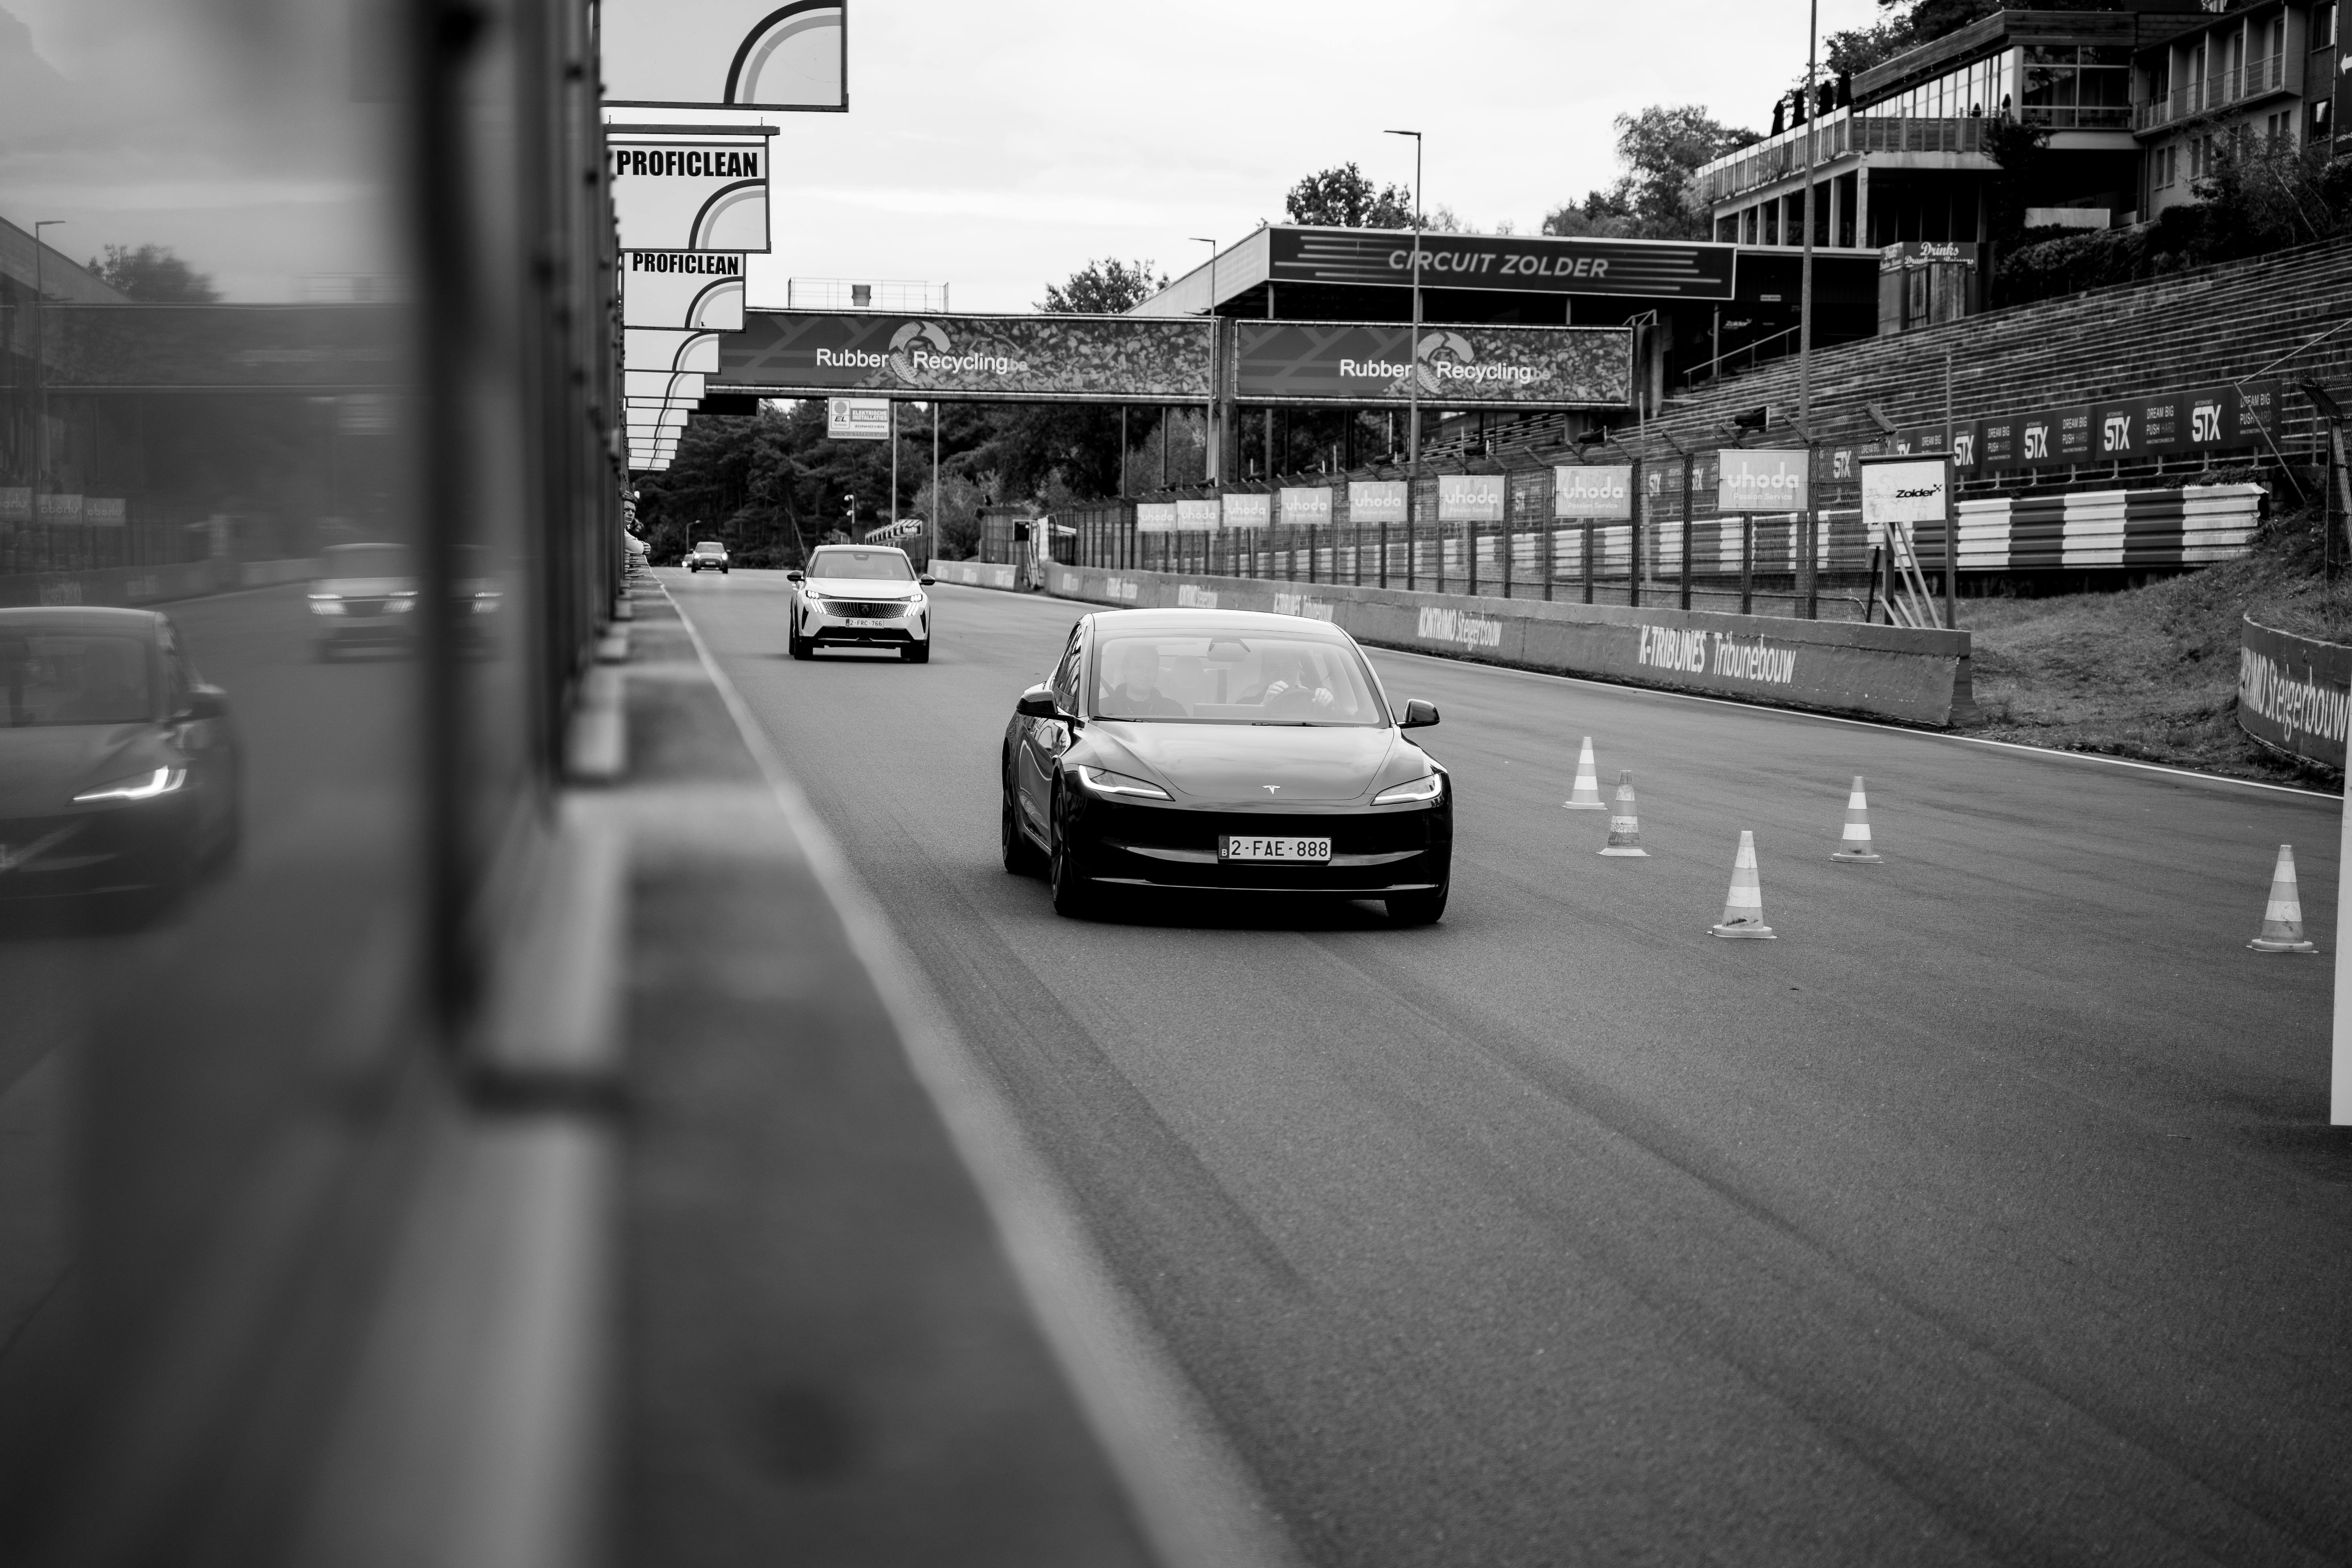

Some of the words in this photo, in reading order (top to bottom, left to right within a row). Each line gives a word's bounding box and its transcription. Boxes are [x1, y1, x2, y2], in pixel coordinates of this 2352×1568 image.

[616, 150, 757, 177] PROFICLEAN
[1920, 242, 1959, 256] Drinks
[632, 253, 738, 275] PROFICLEAN
[1389, 250, 1496, 272] CIRCUIT
[1500, 255, 1609, 277] ZOLDER
[817, 348, 889, 367] Rubber
[914, 351, 1027, 374] Recycling.be
[1340, 359, 1413, 377] Rubber
[2261, 393, 2270, 405] BIG
[2147, 407, 2163, 419] DREAM
[2165, 405, 2174, 417] BIG
[2063, 418, 2078, 429] DREAM
[2079, 417, 2087, 428] BIG
[2147, 423, 2160, 435] PUSH
[2192, 404, 2221, 442] STX
[2025, 426, 2048, 459] STX
[2063, 434, 2075, 444] PUSH
[2104, 416, 2131, 451] STX
[1954, 435, 1974, 466] STX
[1728, 462, 1799, 488] uhoda
[1445, 484, 1497, 504] uhoda
[1563, 476, 1623, 498] uhoda
[1896, 489, 1936, 498] Zolder
[1228, 501, 1266, 514] uhoda
[1286, 495, 1327, 510] uhoda
[1355, 490, 1401, 507] uhoda
[1141, 509, 1174, 520] uhoda
[1182, 506, 1216, 519] uhoda
[1418, 607, 1457, 641] KONTRIMO
[1456, 609, 1502, 651] Steigerbouw
[1639, 624, 1707, 673] K-TRIBUNES
[1714, 630, 1796, 683] Tribunebouw
[2266, 659, 2350, 743] Steigerbouw
[1231, 840, 1328, 857] 2-FAE-888
